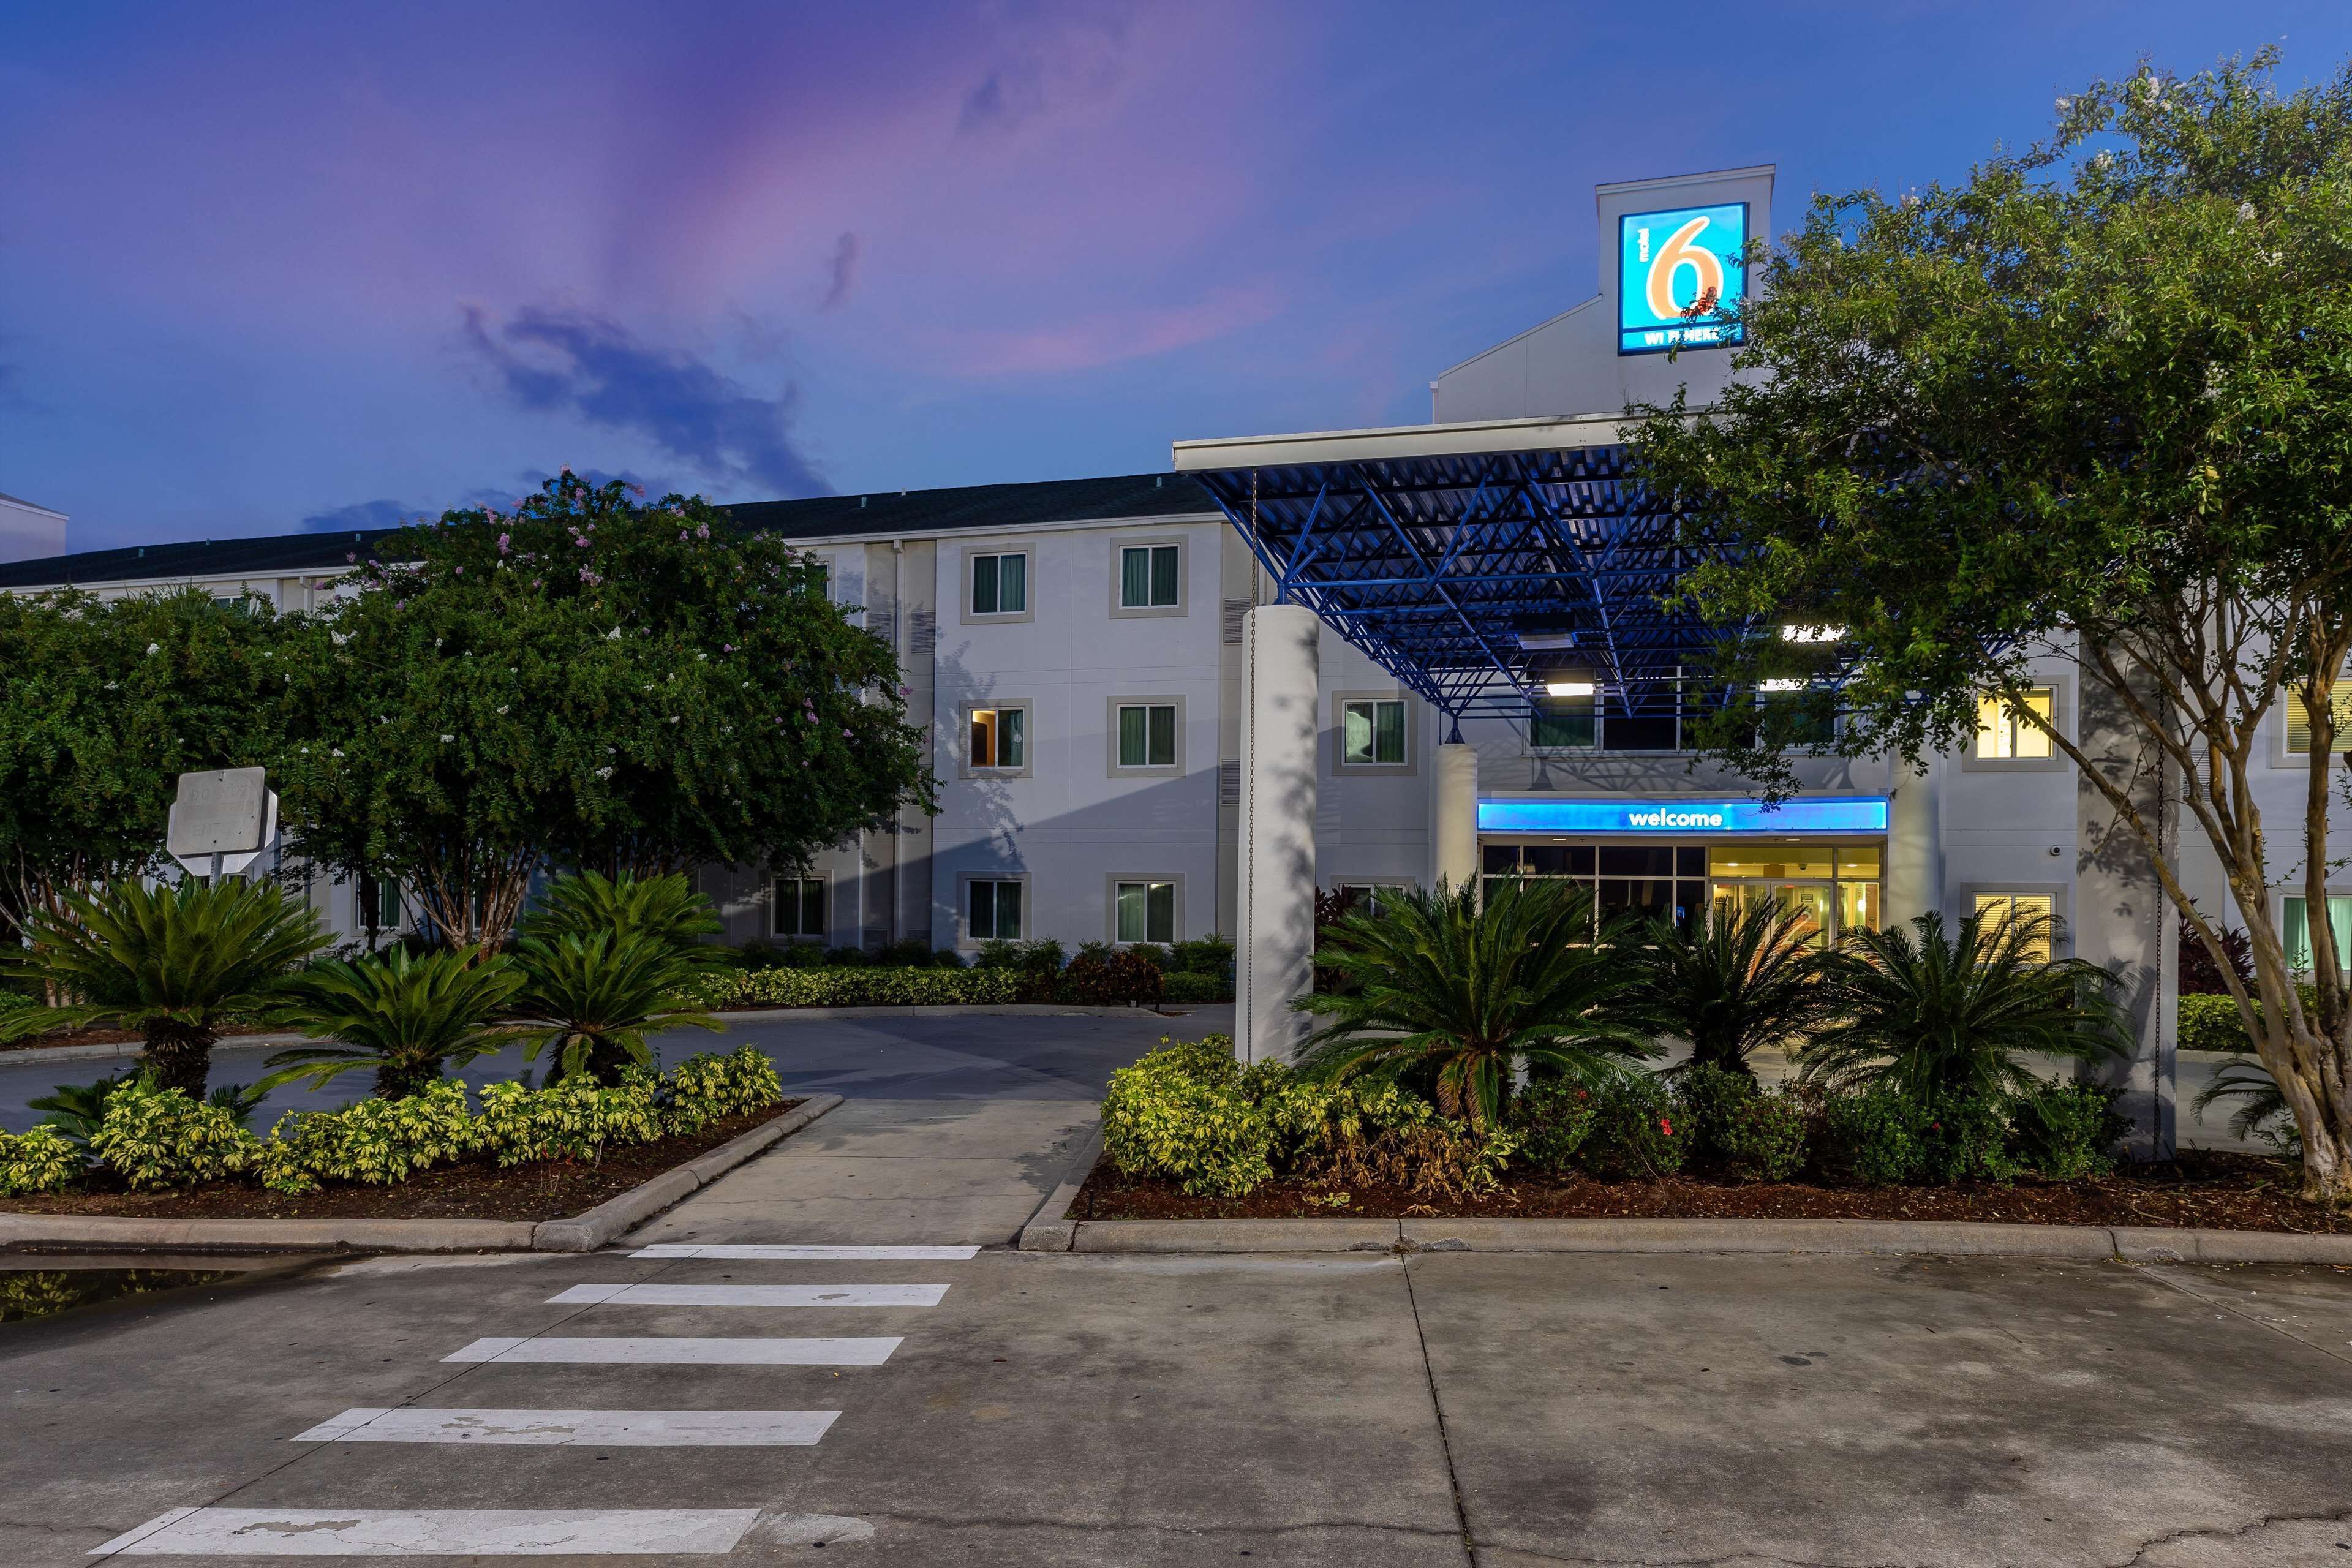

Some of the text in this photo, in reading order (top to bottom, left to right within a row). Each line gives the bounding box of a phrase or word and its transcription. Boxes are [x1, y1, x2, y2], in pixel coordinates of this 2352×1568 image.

[1646, 216, 1724, 320] 6
[1645, 331, 1664, 345] WI
[1629, 808, 1722, 827] welcome
